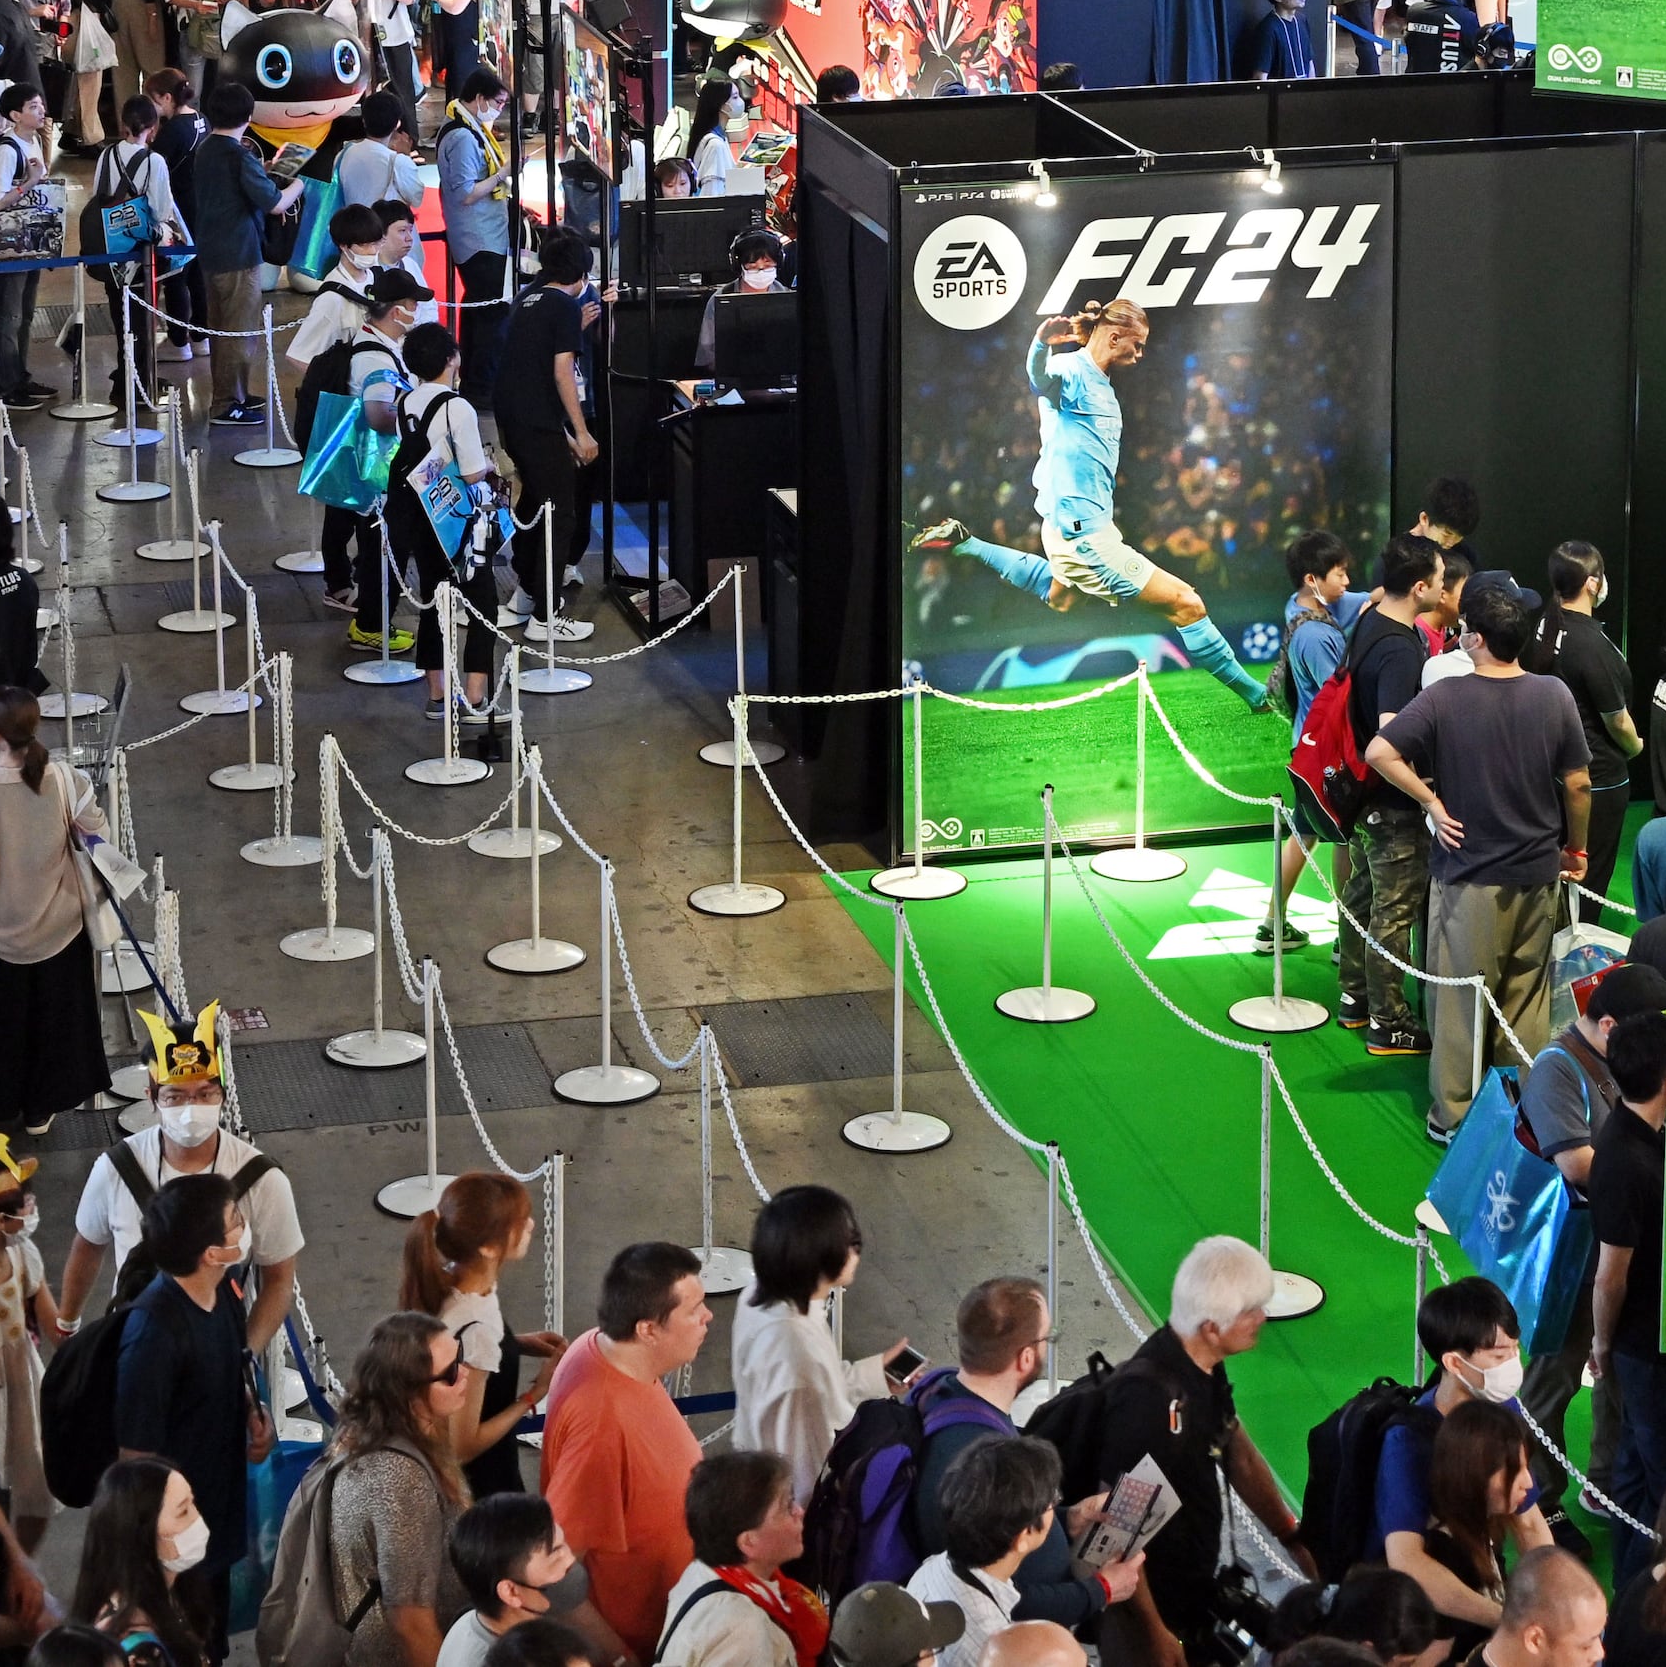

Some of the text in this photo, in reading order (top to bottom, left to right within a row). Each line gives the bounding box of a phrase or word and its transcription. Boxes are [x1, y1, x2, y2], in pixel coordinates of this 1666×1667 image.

[1413, 24, 1433, 34] STAFF
[960, 192, 985, 200] PS4
[934, 241, 1005, 279] EA
[933, 279, 1008, 299] SPORTS
[0, 583, 19, 596] STAFF
